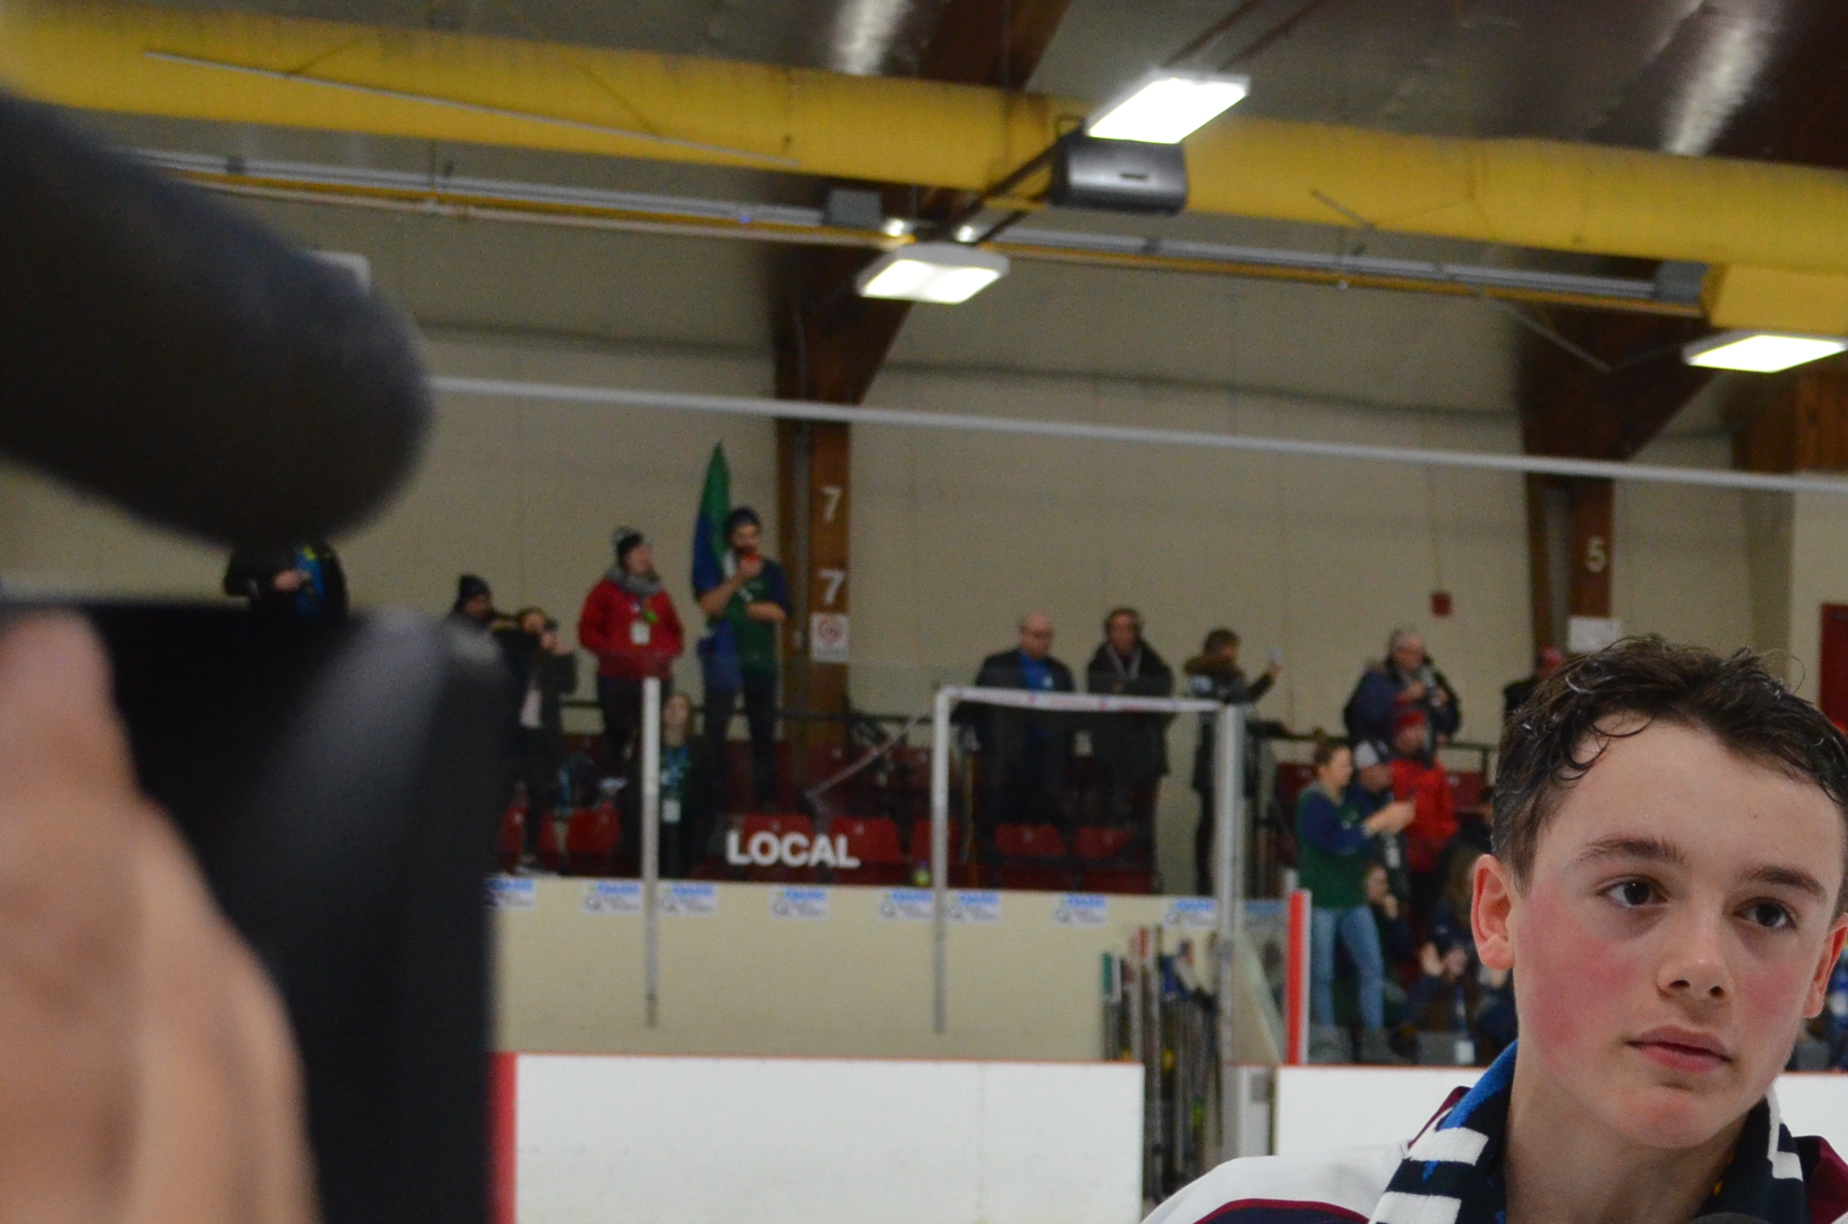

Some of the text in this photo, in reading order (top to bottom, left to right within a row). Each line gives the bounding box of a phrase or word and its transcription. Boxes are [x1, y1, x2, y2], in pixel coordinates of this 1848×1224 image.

[822, 486, 842, 522] 7
[1586, 537, 1607, 573] 5
[819, 569, 847, 605] 7
[726, 829, 861, 869] LOCAL
